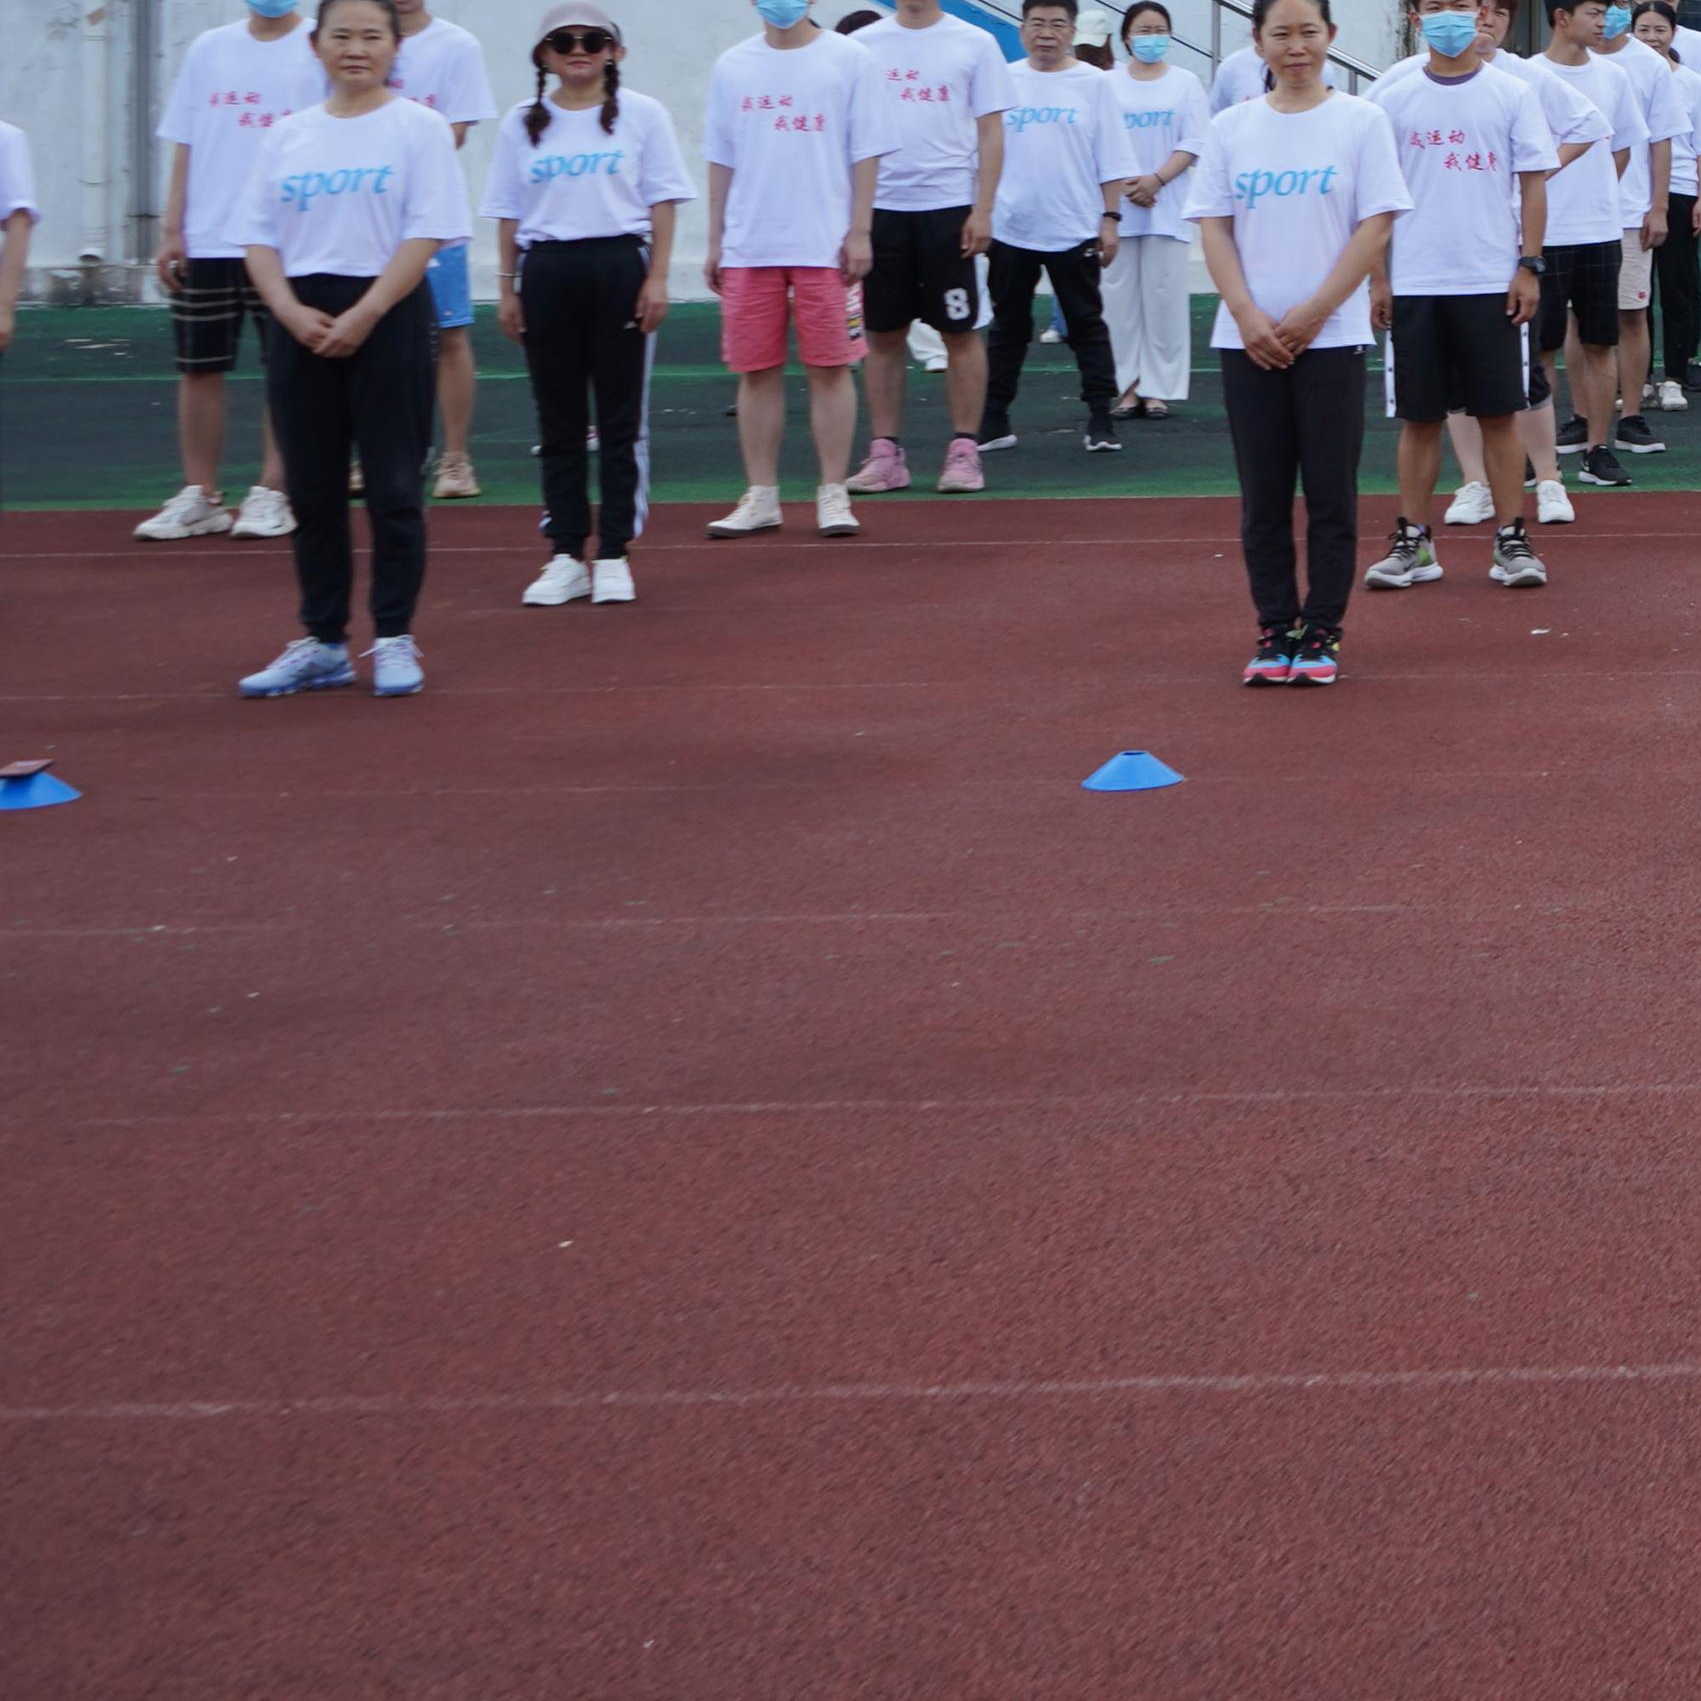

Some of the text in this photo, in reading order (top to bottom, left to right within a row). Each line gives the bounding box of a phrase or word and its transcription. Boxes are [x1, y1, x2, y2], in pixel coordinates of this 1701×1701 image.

[1005, 106, 1079, 133] sport
[530, 150, 625, 184] sport
[280, 164, 395, 212] sport
[1235, 164, 1339, 210] sport
[944, 288, 970, 321] 8
